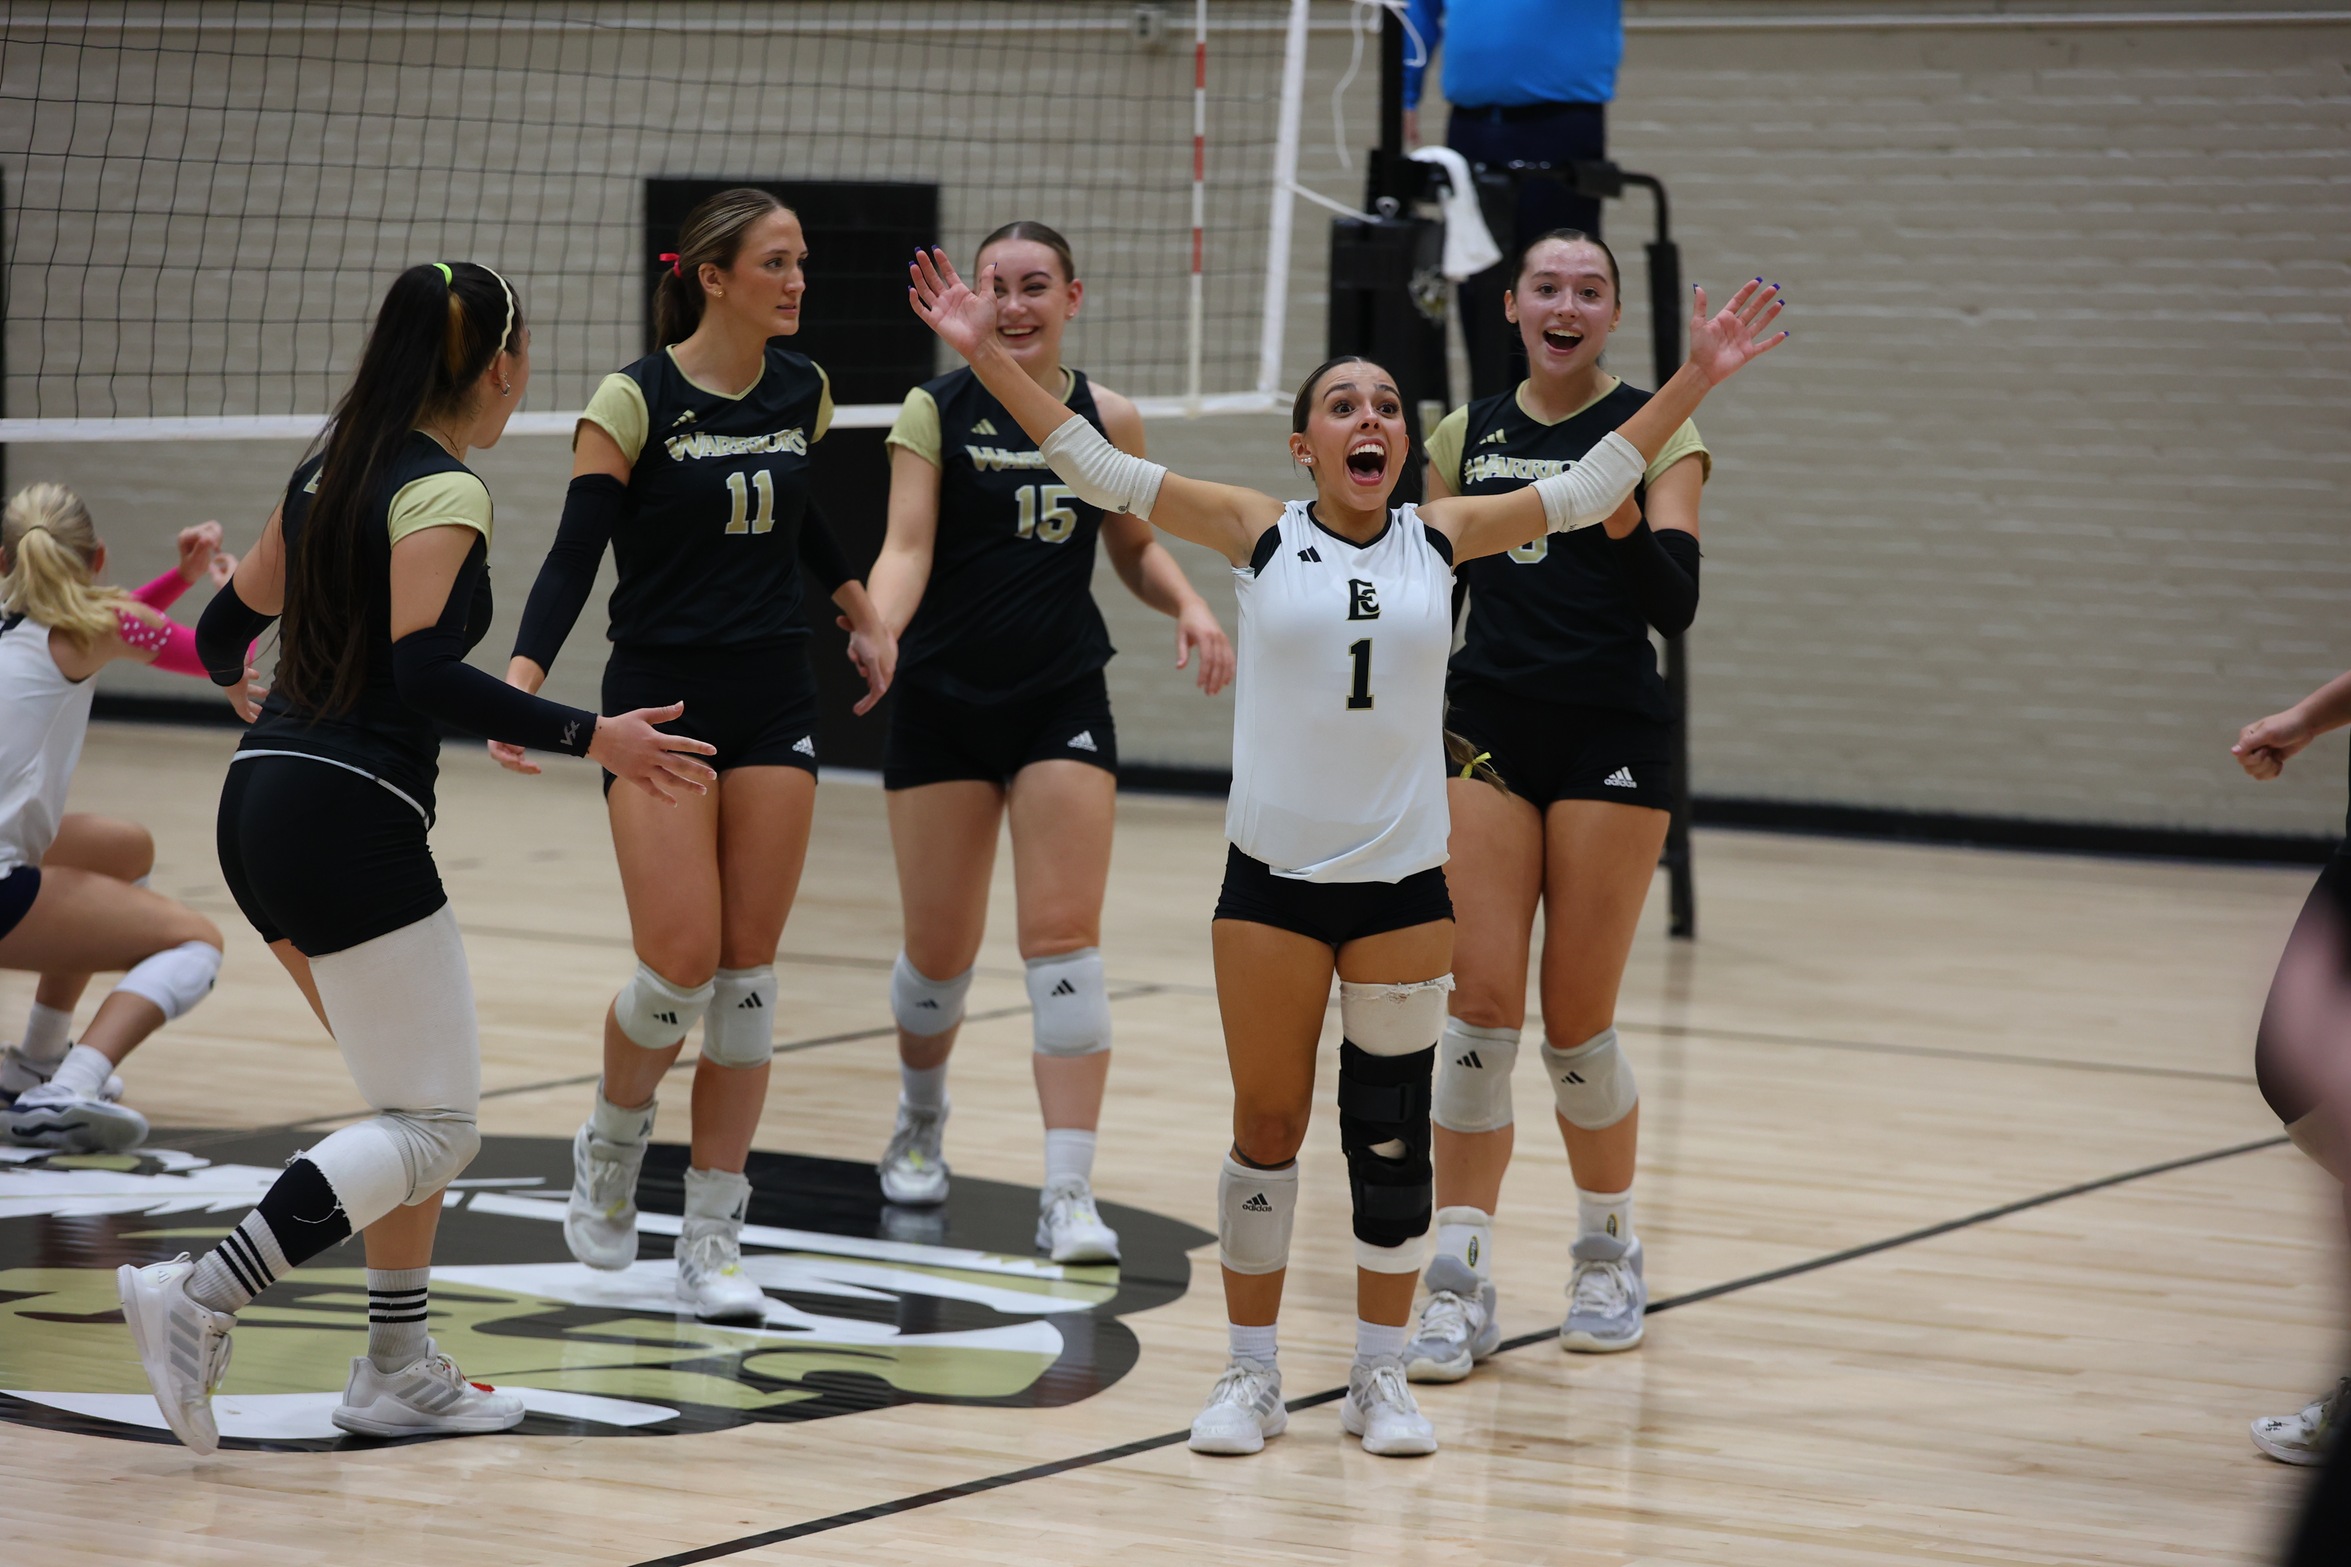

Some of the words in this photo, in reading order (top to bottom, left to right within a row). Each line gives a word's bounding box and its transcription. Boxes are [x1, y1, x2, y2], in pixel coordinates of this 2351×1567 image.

[725, 469, 775, 534] 11
[1014, 484, 1078, 544] 15
[1345, 637, 1374, 711] 1
